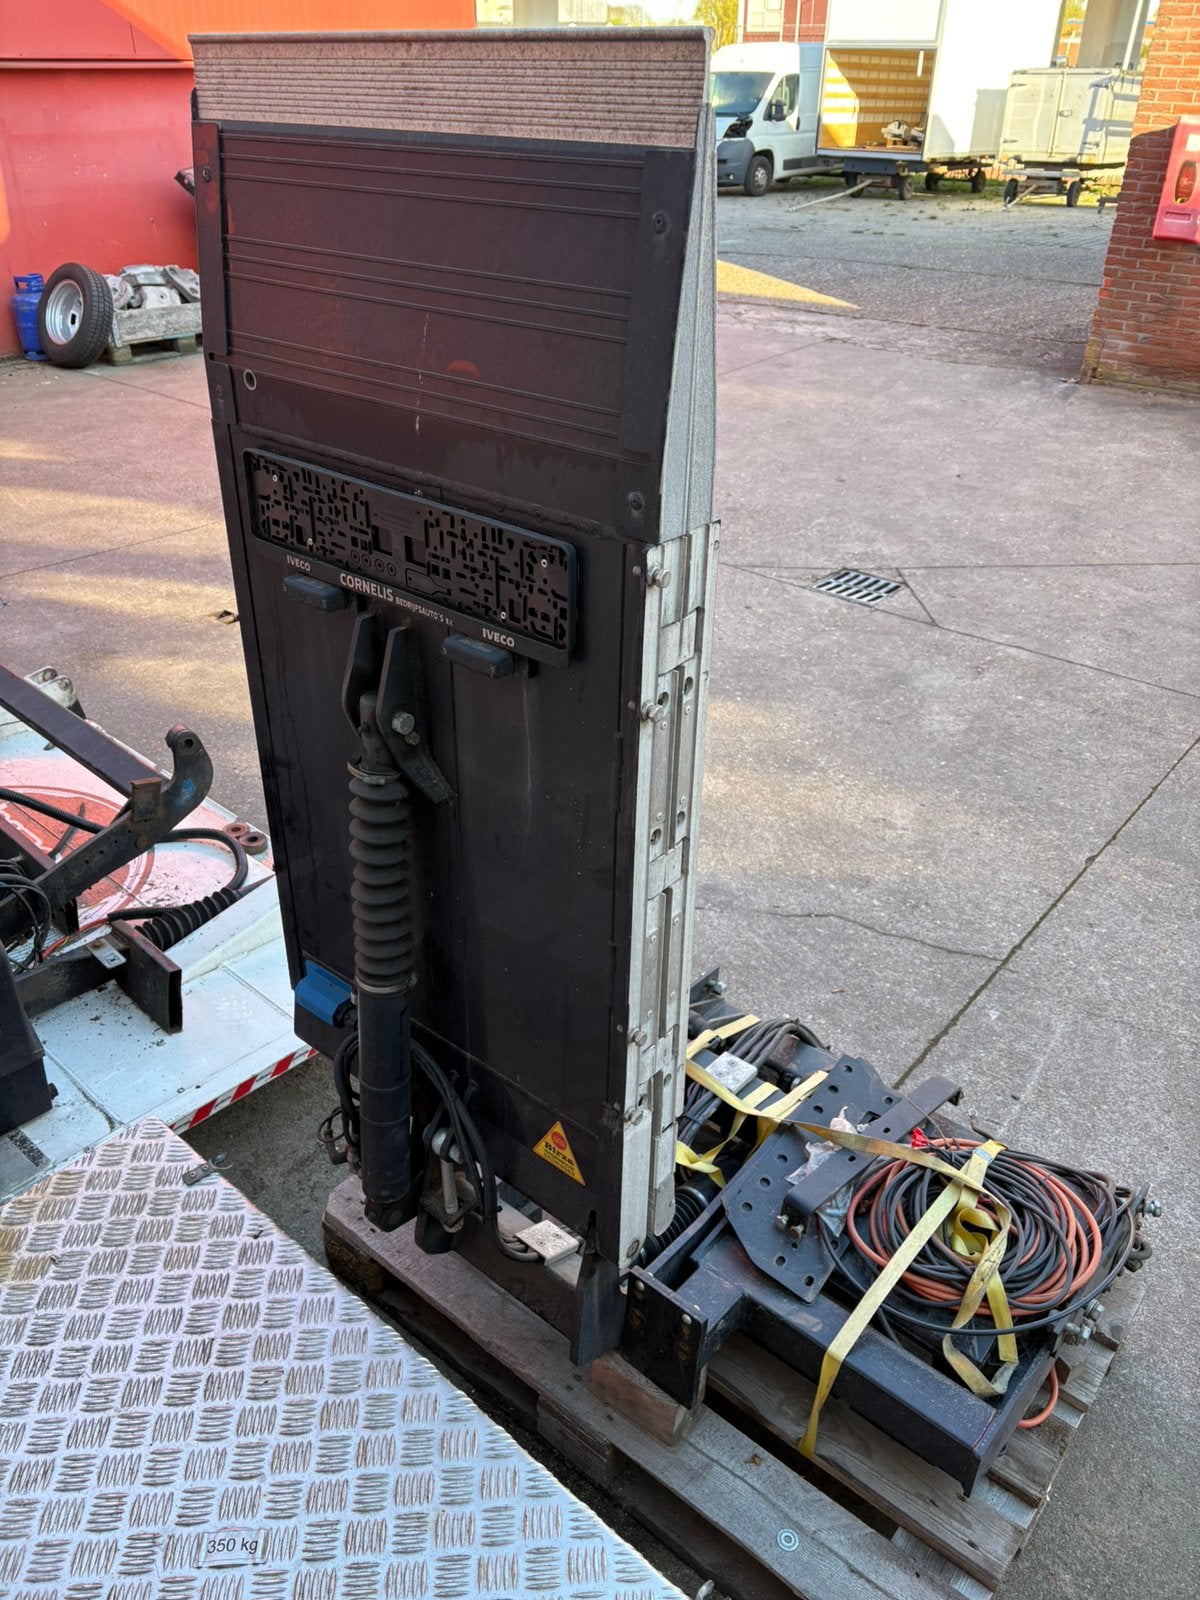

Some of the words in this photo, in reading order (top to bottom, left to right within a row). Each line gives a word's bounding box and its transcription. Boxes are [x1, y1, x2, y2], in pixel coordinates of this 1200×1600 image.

[286, 554, 312, 573] IVECO
[340, 573, 395, 603] CORNELIS
[395, 596, 444, 623] BEDRIJFSAUTO'S
[482, 628, 516, 649] IVECO
[207, 1537, 236, 1554] 350
[240, 1537, 259, 1555] kg
